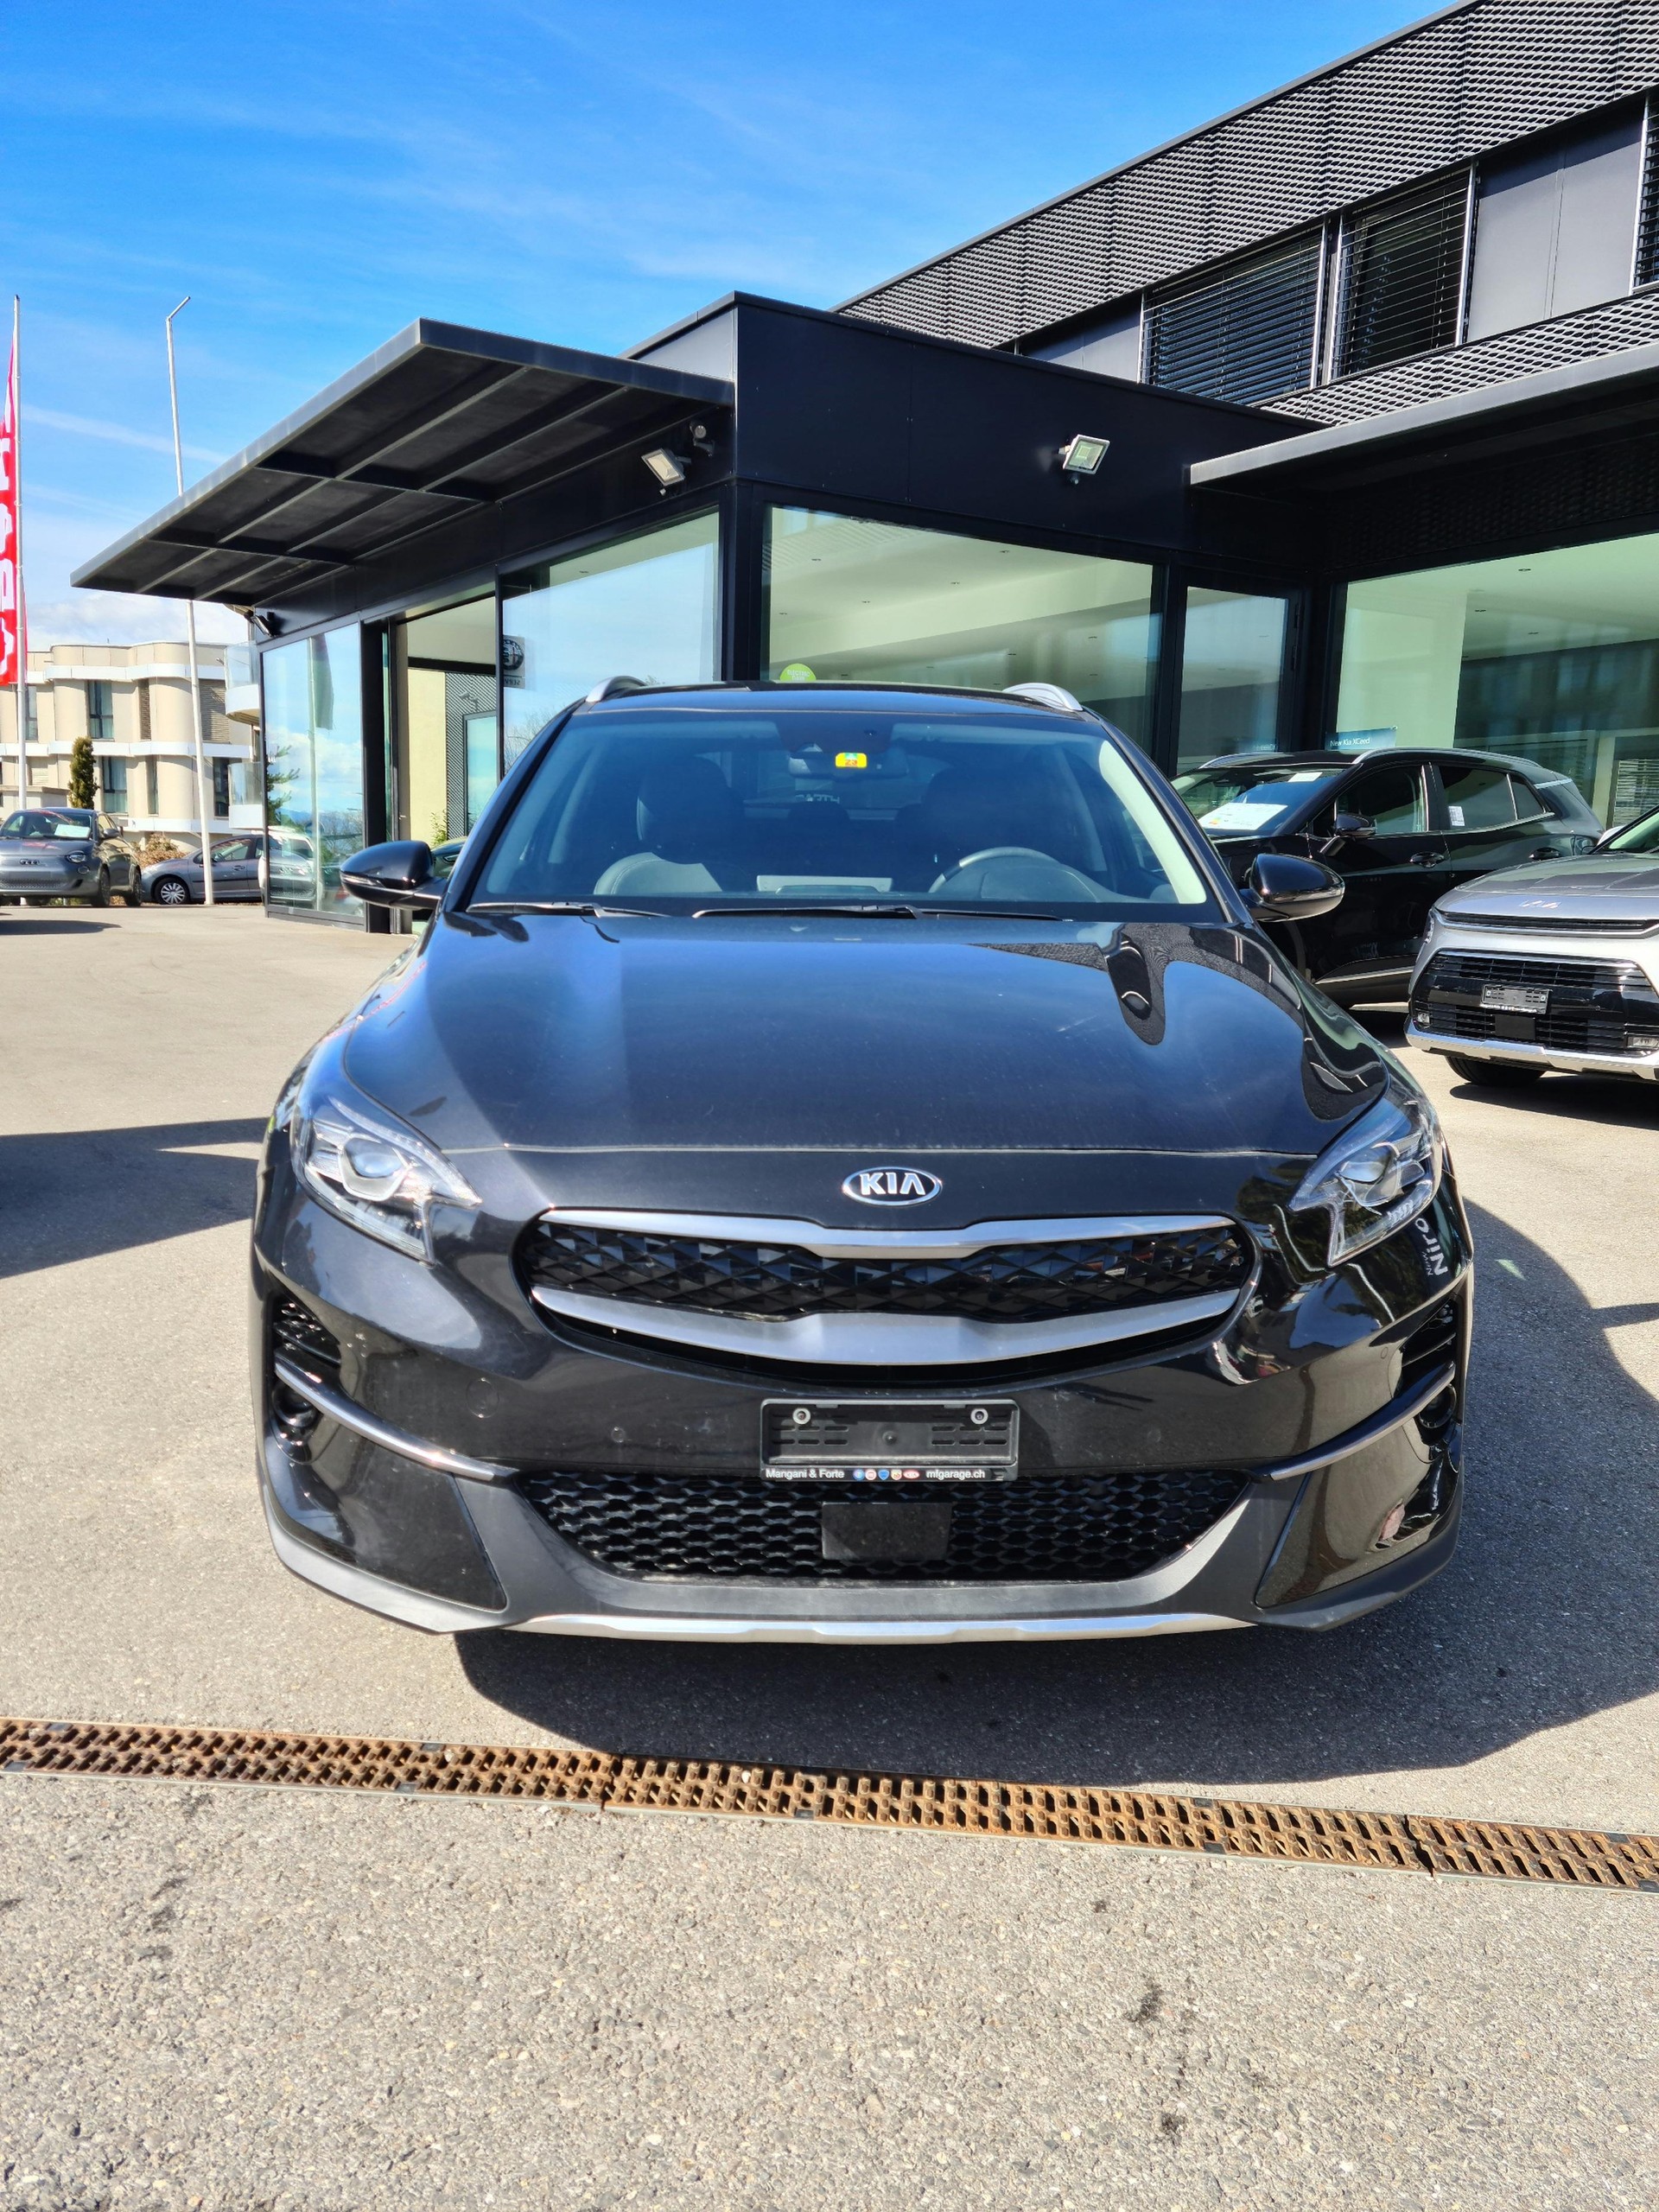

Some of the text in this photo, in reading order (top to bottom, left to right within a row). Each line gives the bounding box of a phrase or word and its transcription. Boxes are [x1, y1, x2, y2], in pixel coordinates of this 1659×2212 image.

[859, 1172, 926, 1195] KIA
[766, 1468, 845, 1480] Mangani & Forte
[925, 1469, 986, 1480] mfgarage.ch
